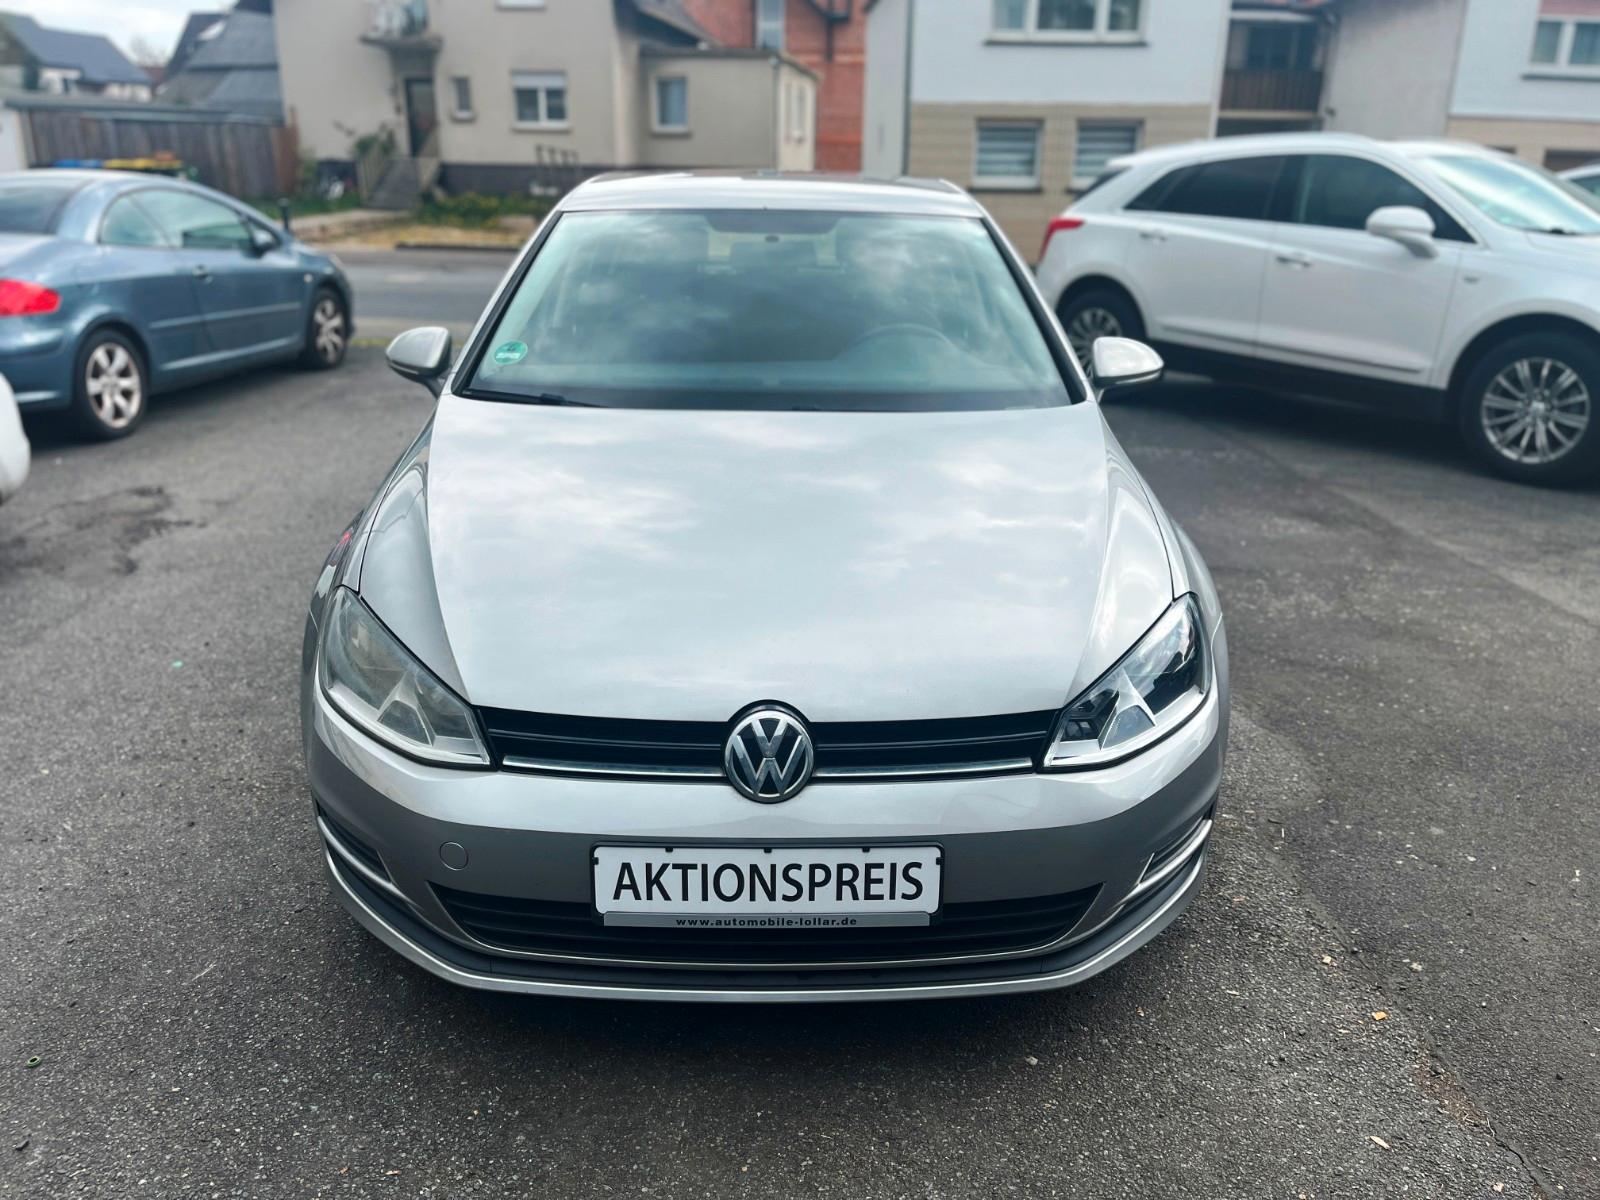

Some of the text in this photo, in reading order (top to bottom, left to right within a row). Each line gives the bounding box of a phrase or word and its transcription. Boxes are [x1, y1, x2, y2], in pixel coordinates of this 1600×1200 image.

[728, 714, 811, 799] VW
[612, 862, 924, 902] AKTIONSPREIS
[676, 917, 857, 927] www.automobile-lollar.de
